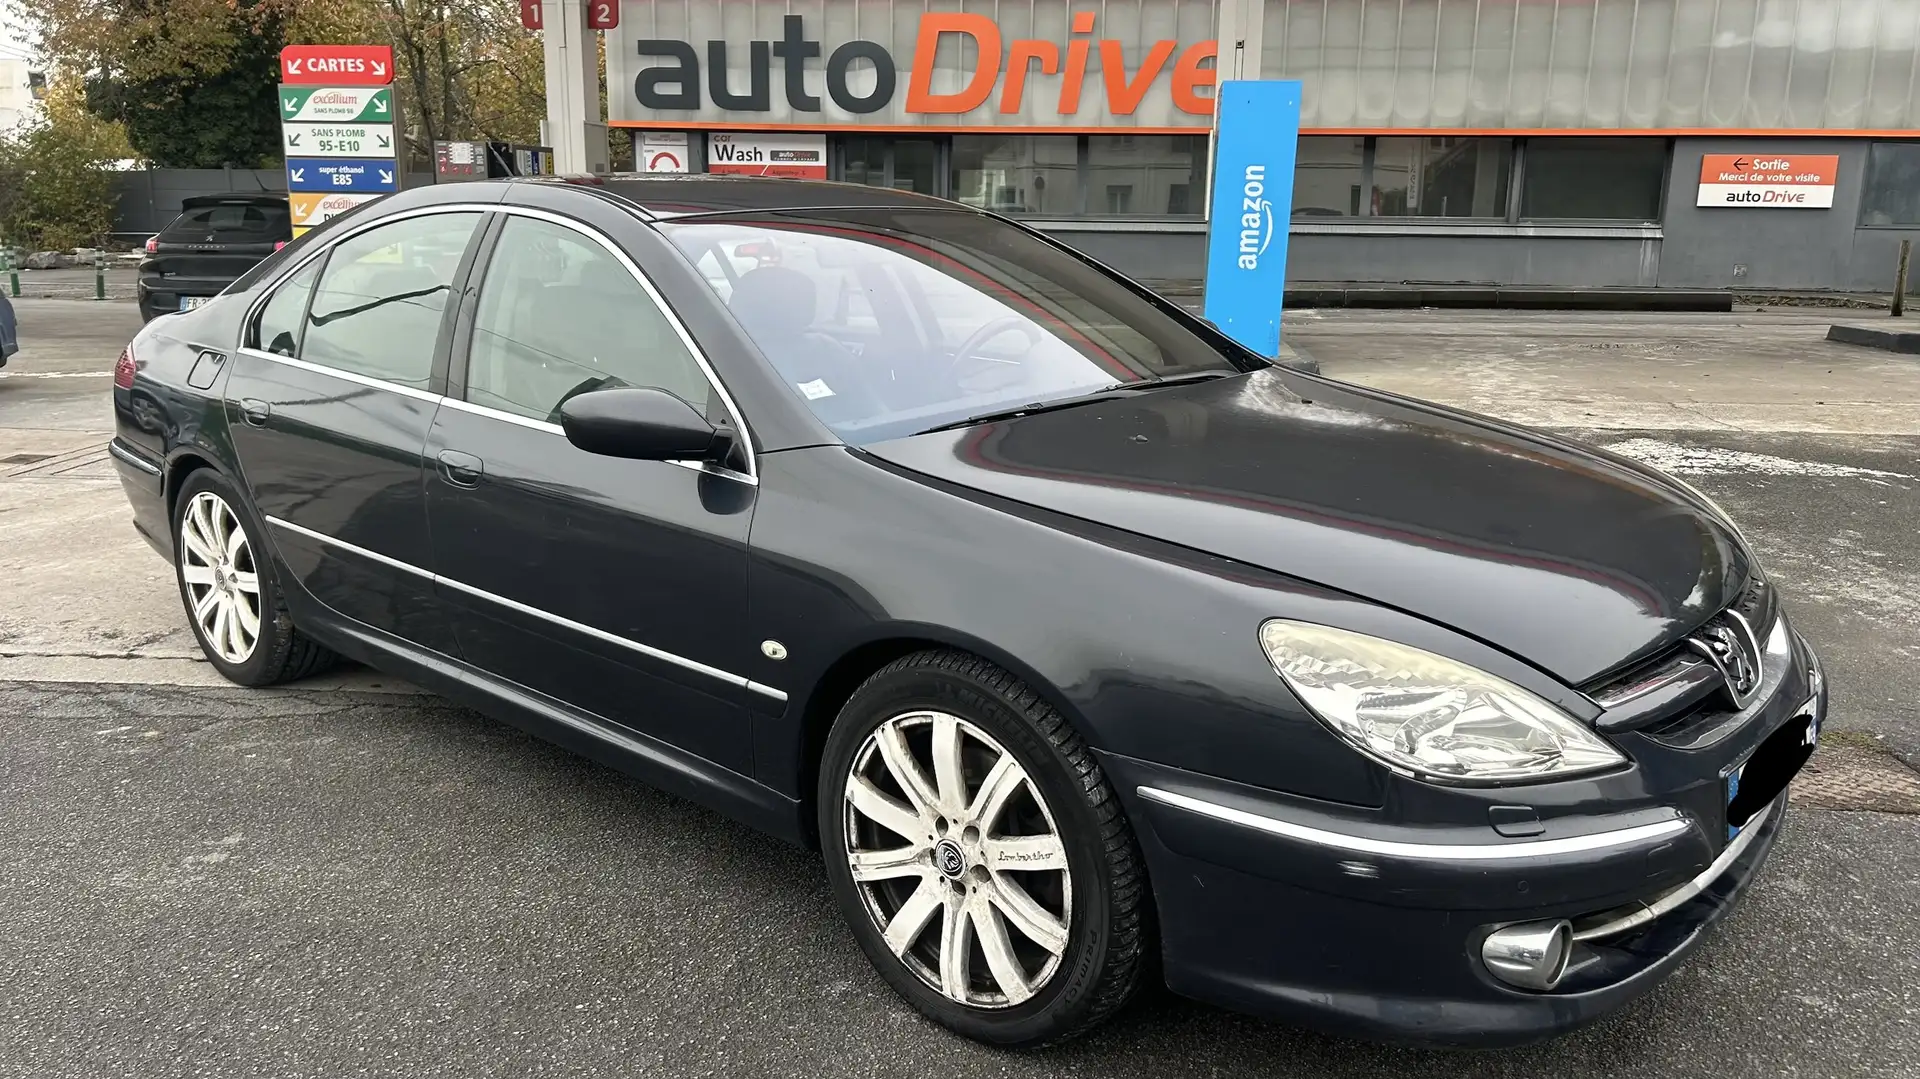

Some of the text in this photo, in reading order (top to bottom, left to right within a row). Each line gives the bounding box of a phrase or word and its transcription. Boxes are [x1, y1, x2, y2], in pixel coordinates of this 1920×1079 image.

[530, 4, 539, 22] 1
[597, 4, 610, 22] 2
[307, 58, 365, 73] CARTES
[313, 92, 357, 104] excellium
[311, 128, 366, 137] SANS PLOMB
[319, 140, 360, 151] 95-E10
[714, 144, 763, 162] Wash
[1752, 159, 1790, 170] Sortie
[332, 174, 352, 185] E85
[1718, 172, 1820, 182] Merci de votre visite
[1238, 165, 1265, 270] amazon
